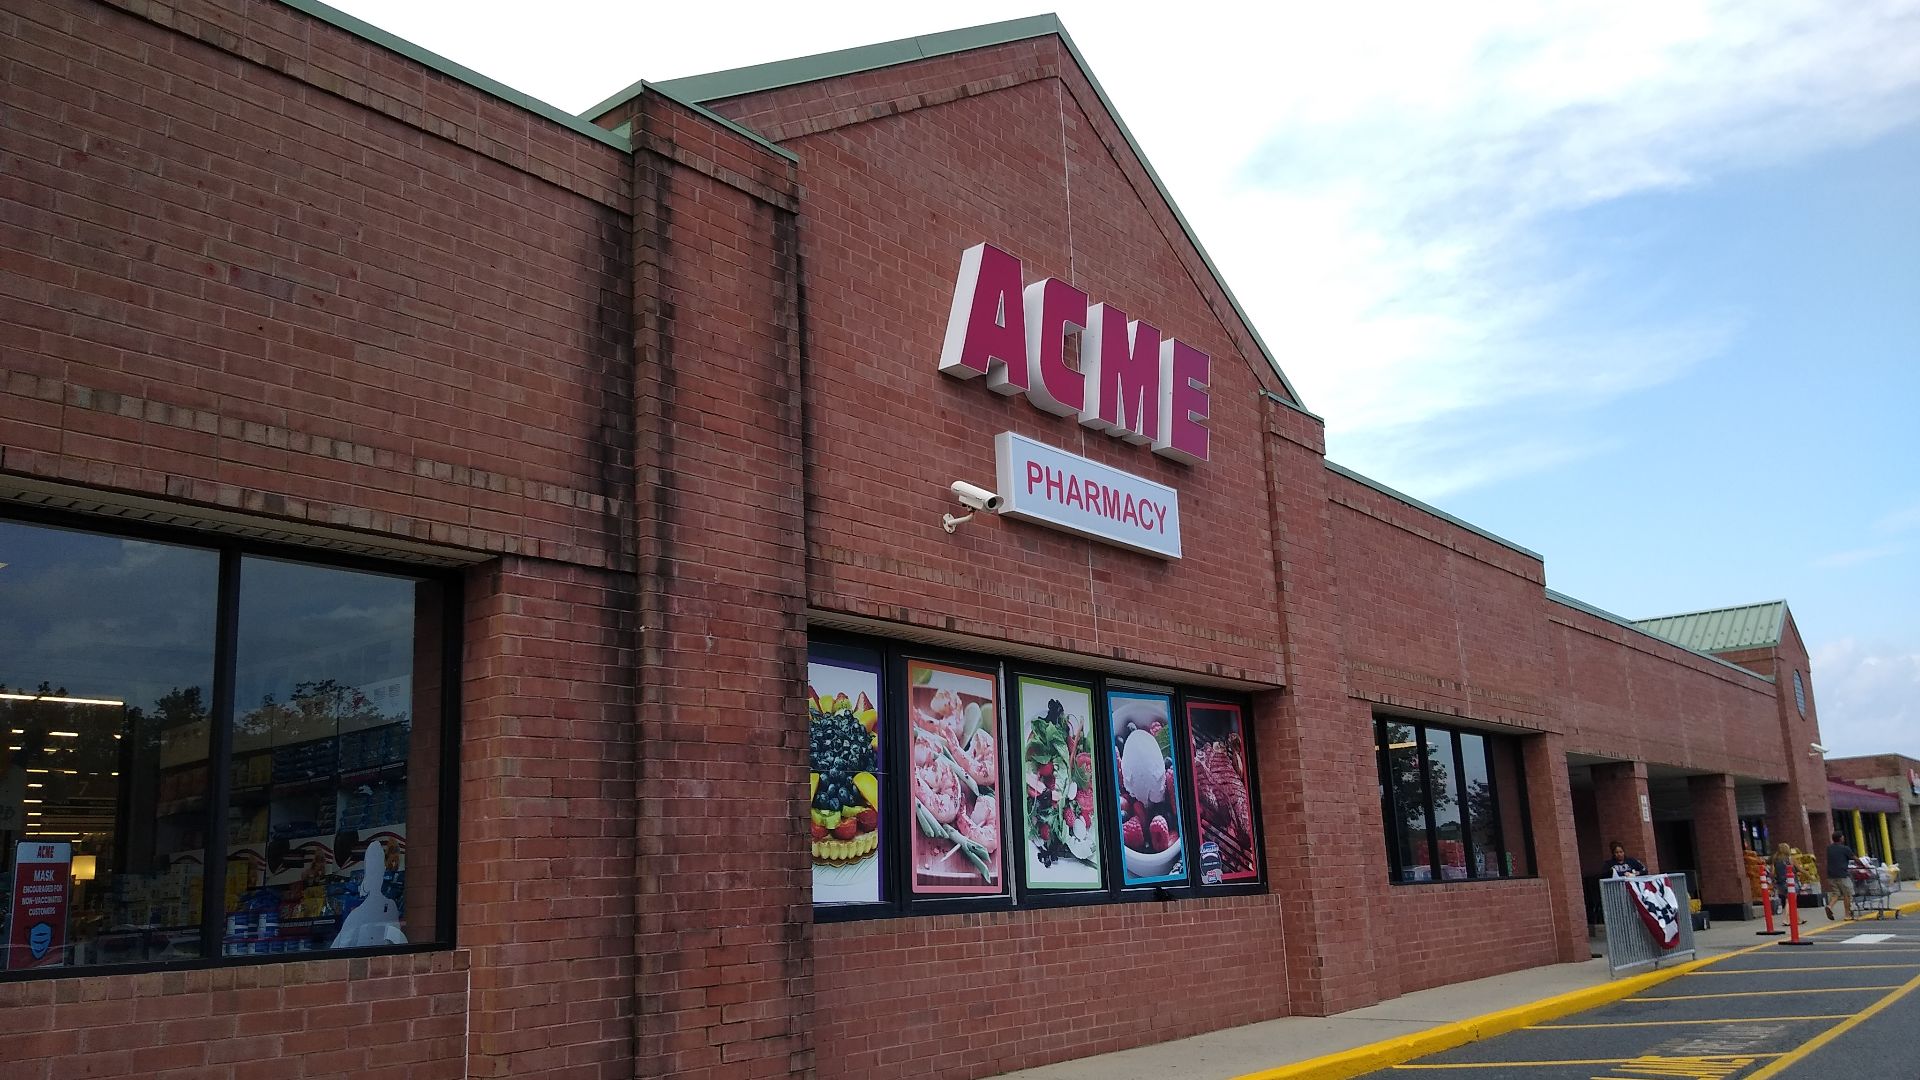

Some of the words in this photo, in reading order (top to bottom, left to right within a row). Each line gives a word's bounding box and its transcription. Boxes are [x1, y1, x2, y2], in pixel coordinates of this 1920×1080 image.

[940, 242, 1211, 463] ACME
[1026, 460, 1167, 535] PHARMACY
[37, 845, 55, 859] ACME
[33, 870, 55, 881] MASK
[23, 885, 54, 894] ENCOURAGED
[28, 907, 56, 916] CUSTOMERS
